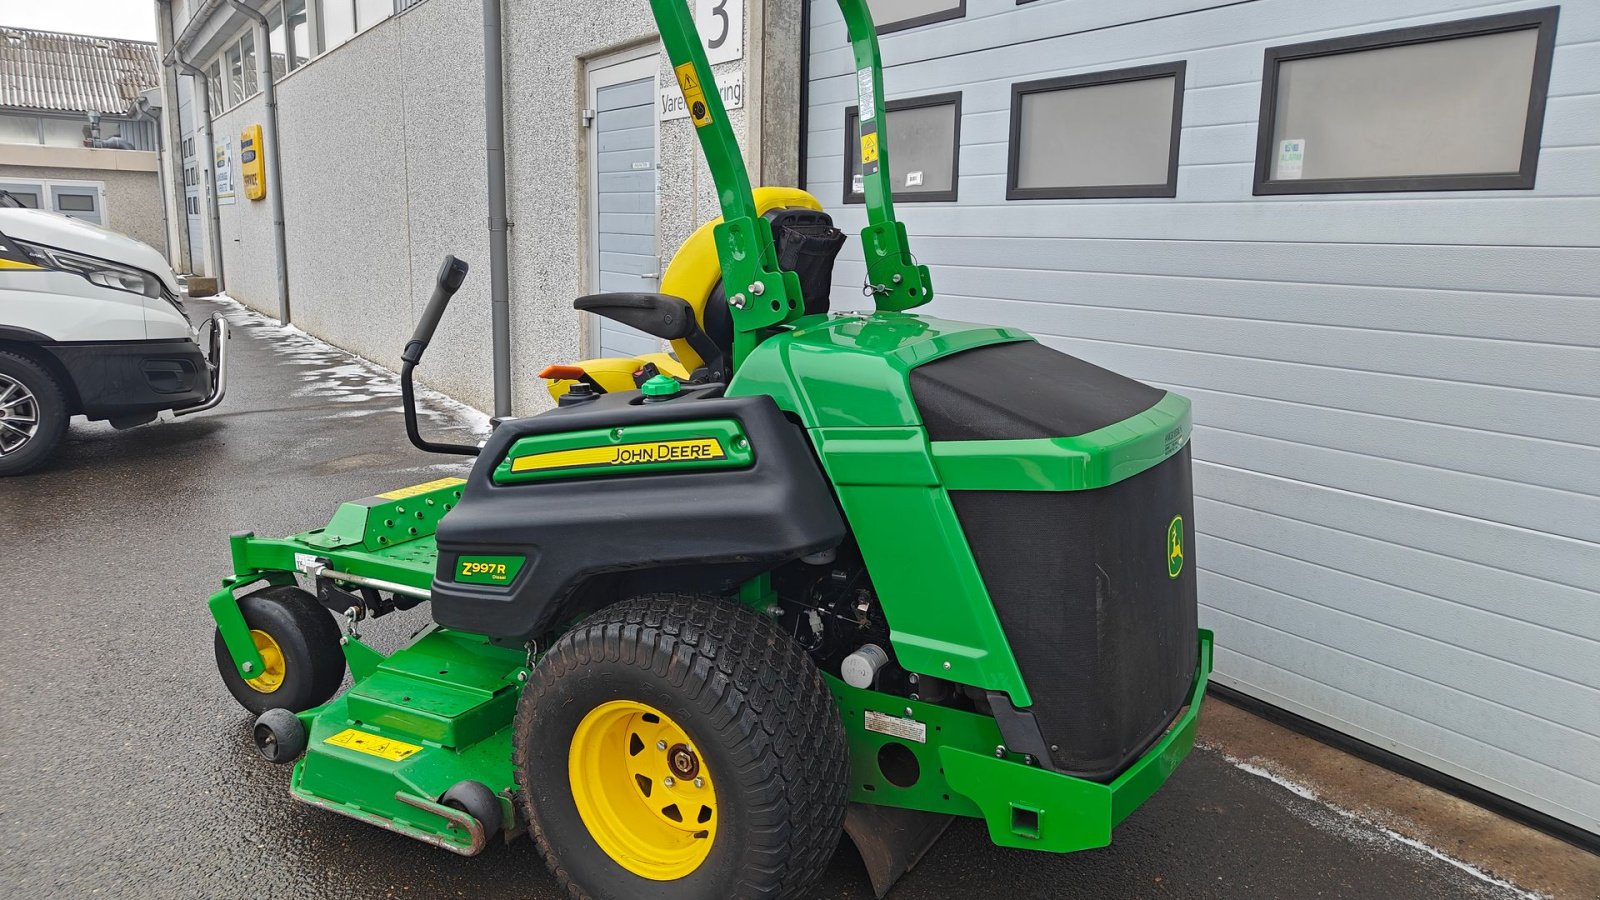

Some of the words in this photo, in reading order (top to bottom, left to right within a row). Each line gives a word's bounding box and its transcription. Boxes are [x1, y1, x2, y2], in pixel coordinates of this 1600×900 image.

[708, 0, 729, 49] 3
[662, 79, 741, 114] Varering
[611, 448, 653, 463] JOHN
[658, 444, 711, 459] DEERE
